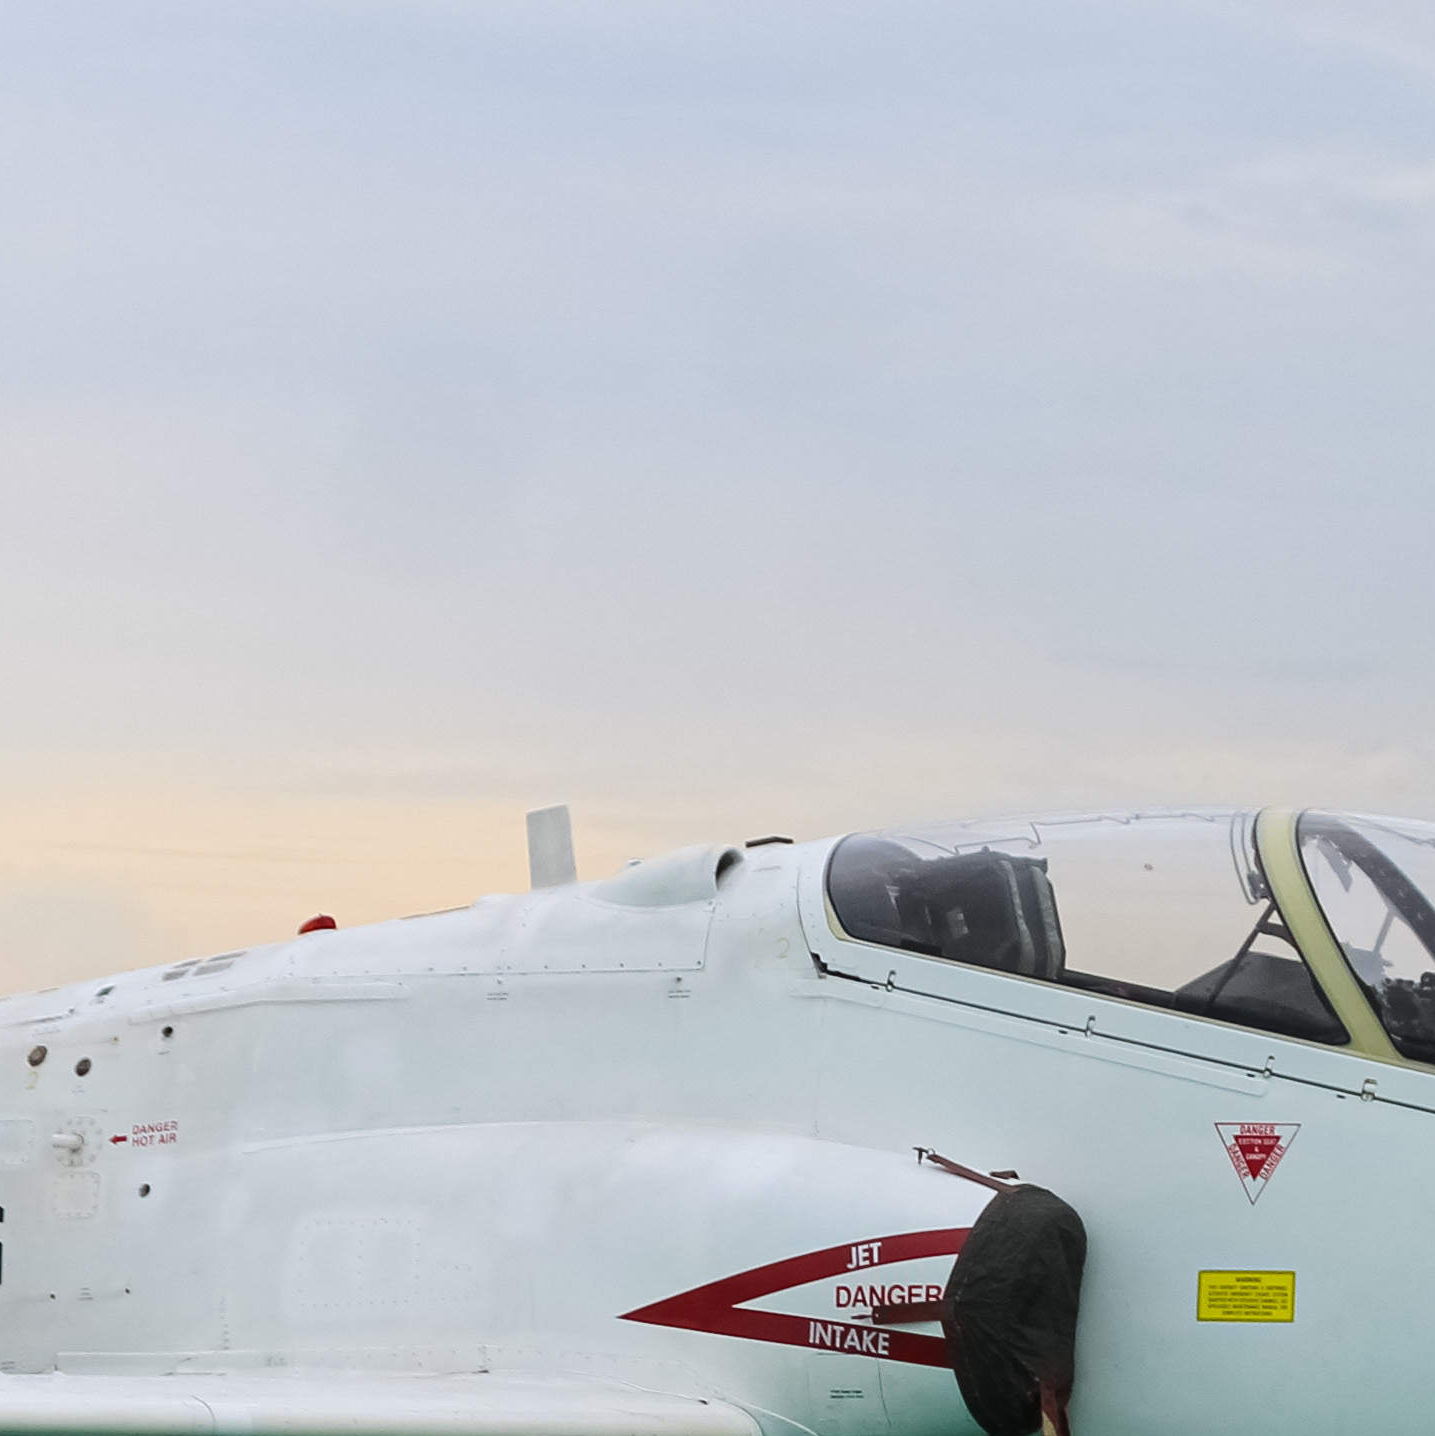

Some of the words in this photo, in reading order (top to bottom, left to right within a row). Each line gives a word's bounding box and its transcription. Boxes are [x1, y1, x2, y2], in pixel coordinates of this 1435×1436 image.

[131, 1134, 154, 1147] HOT
[158, 1132, 177, 1144] AIR
[132, 1120, 178, 1135] DANGER
[1239, 1124, 1275, 1135] DANGER
[1228, 1143, 1250, 1179] DANGER
[1259, 1143, 1285, 1180] DANGER
[846, 1242, 882, 1269] JET
[835, 1285, 944, 1308] DANGER
[809, 1321, 890, 1356] INTAKE
